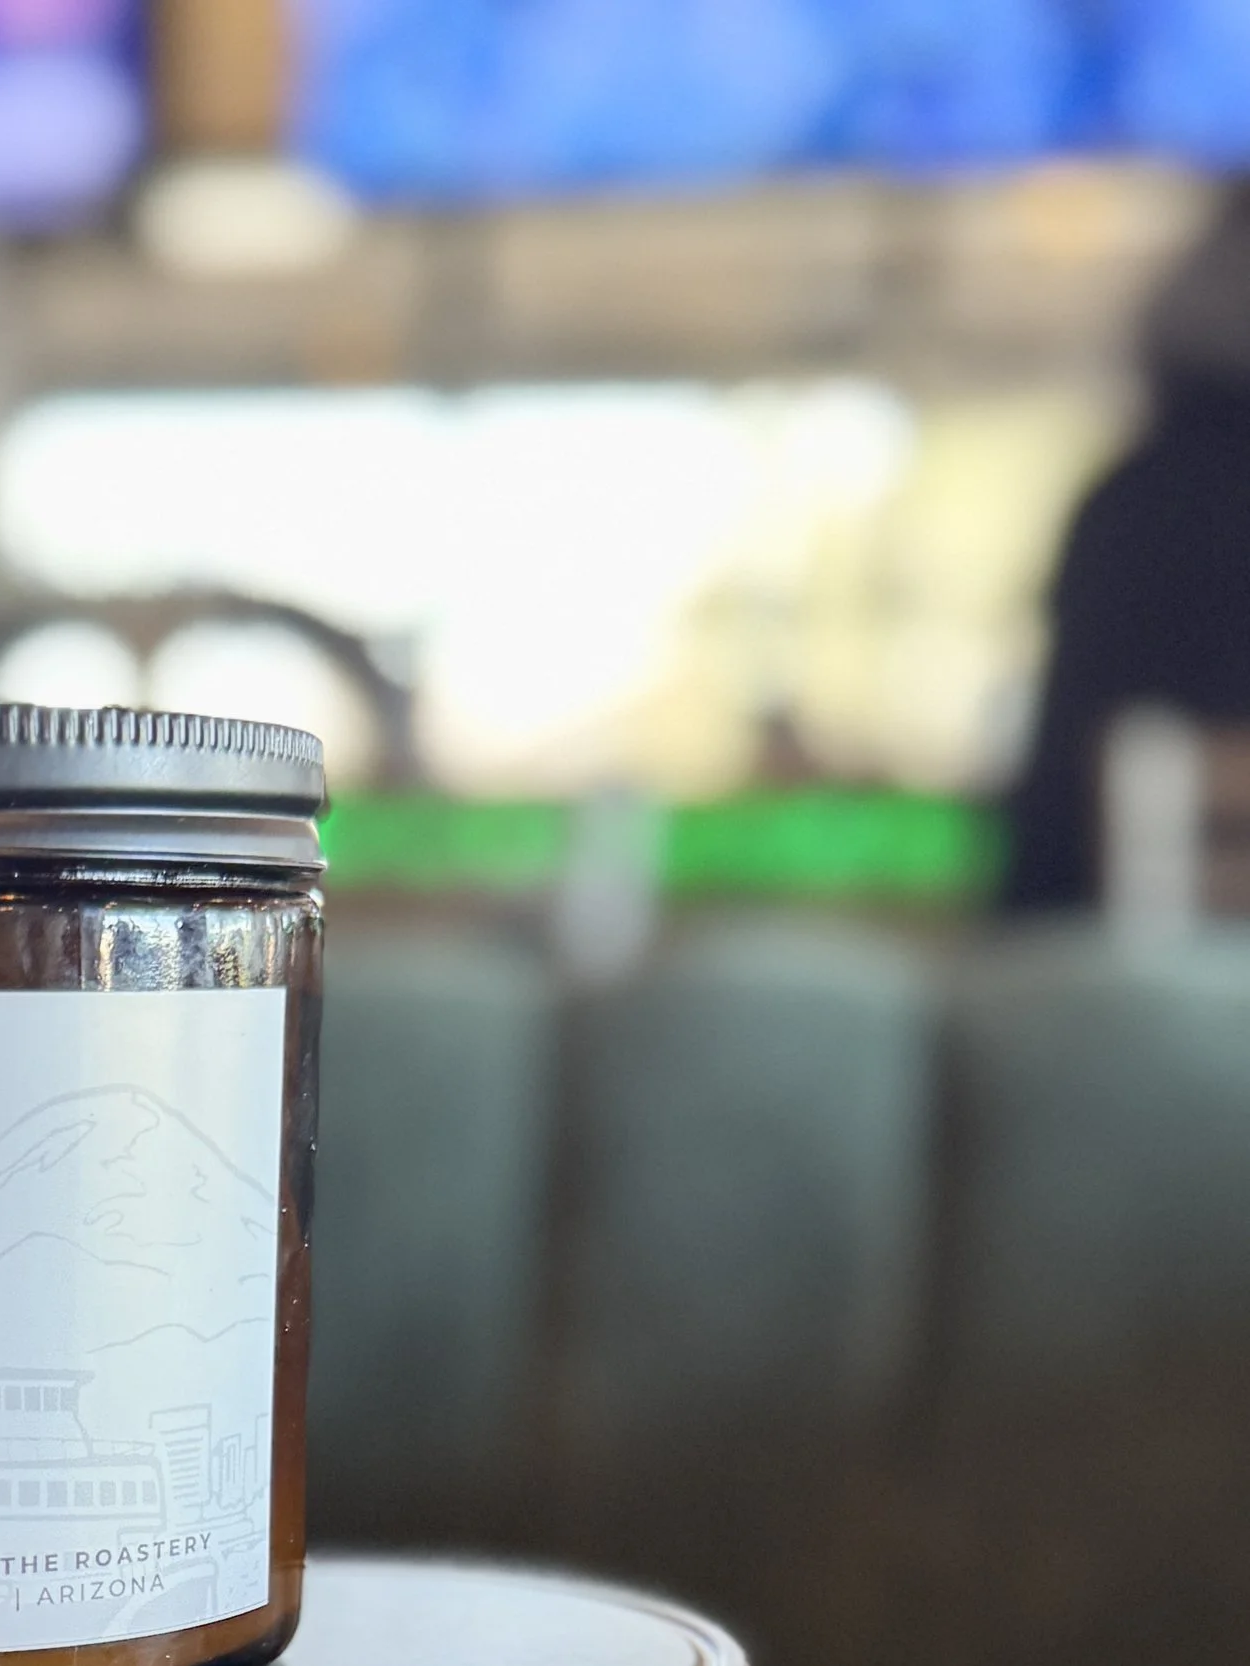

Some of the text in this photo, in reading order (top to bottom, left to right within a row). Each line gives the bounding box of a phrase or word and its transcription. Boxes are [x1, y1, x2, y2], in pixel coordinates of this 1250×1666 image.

[0, 1553, 59, 1576] THE
[75, 1532, 212, 1571] ROASTERY
[36, 1573, 166, 1606] ARIZONA
